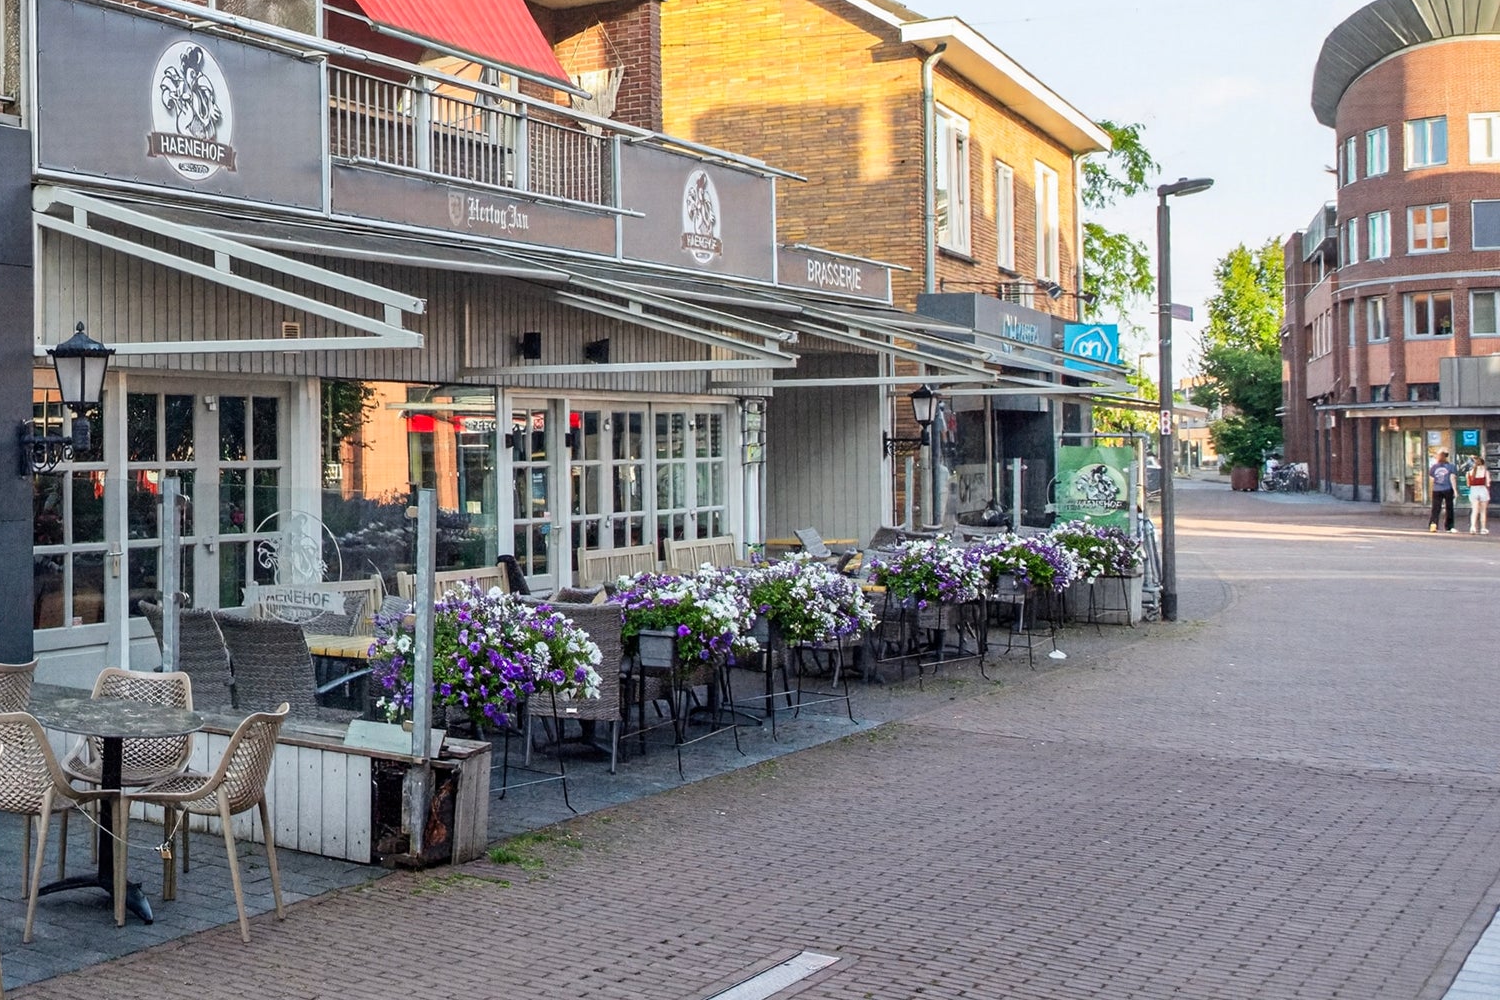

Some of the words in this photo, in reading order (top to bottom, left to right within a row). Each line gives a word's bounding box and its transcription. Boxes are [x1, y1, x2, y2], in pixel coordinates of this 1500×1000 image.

[161, 135, 225, 162] HAENEHOF
[468, 196, 508, 230] Hertog
[507, 204, 529, 234] Jan
[807, 259, 862, 292] BRASSERIE
